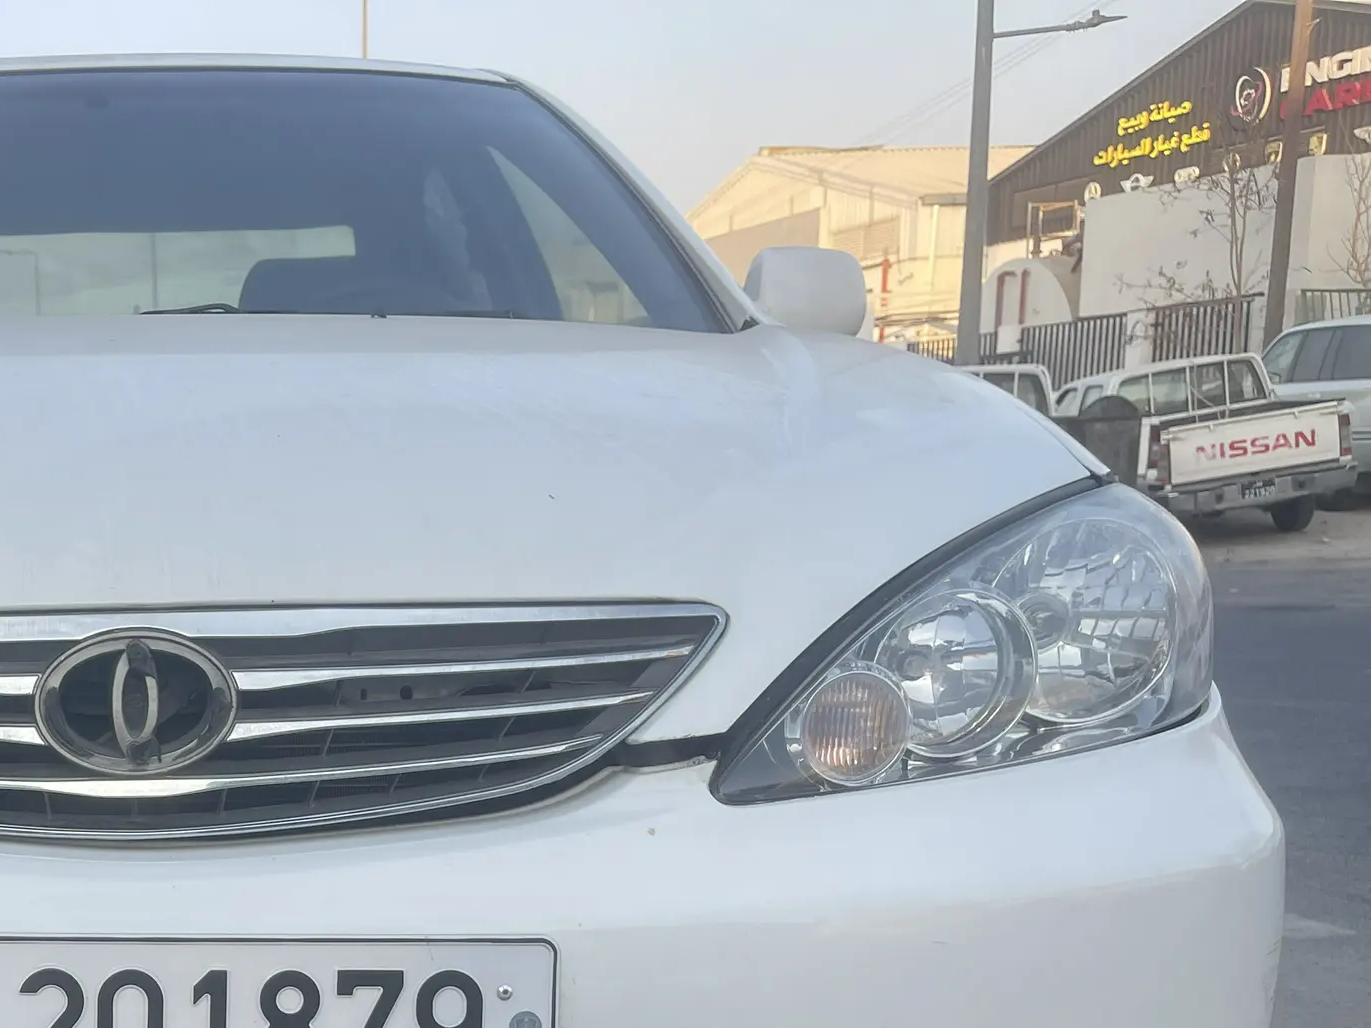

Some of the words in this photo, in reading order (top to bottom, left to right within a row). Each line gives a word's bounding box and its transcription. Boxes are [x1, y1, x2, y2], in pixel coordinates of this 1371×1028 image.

[1118, 111, 1150, 136] وبيع
[1150, 101, 1192, 123] صيانة
[1150, 131, 1180, 158] غيار
[1180, 122, 1211, 153] قطع
[1093, 137, 1152, 168] السيارات
[1195, 428, 1316, 460] NISSAN
